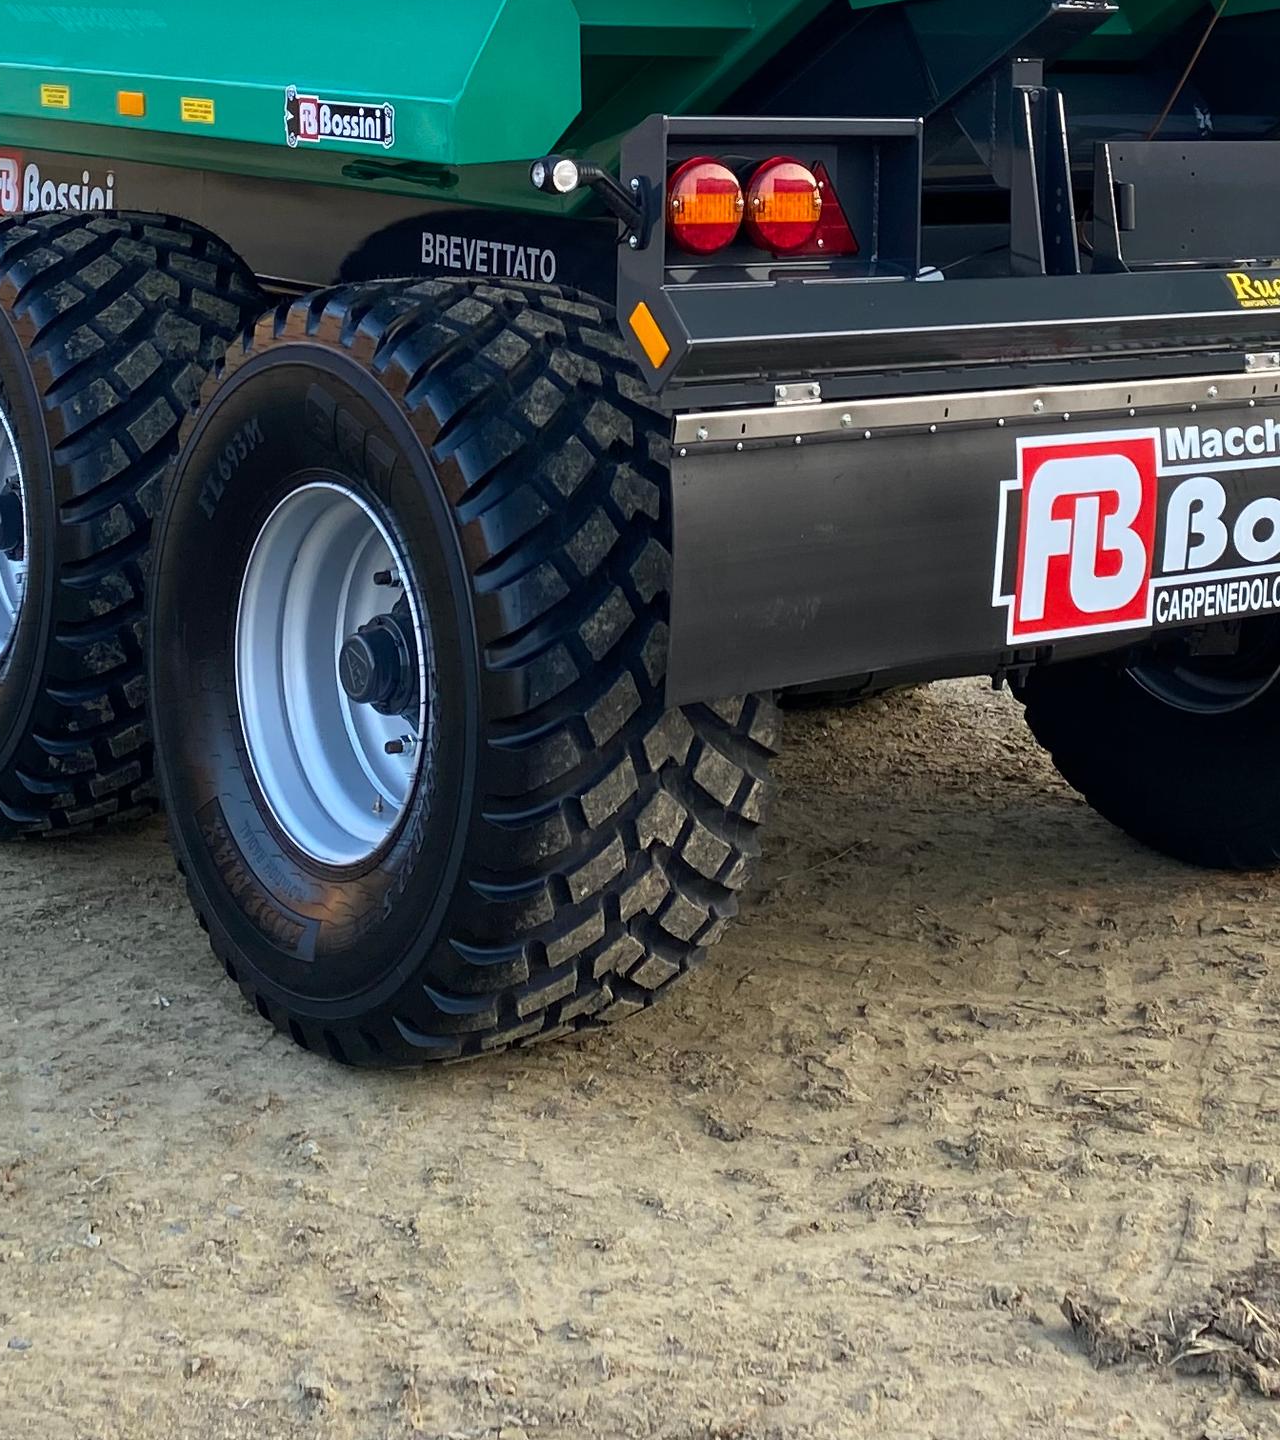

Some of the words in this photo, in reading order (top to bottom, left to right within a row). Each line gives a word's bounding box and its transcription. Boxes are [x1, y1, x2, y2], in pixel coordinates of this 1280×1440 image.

[320, 104, 381, 140] Bossini
[23, 163, 115, 212] Bossini
[421, 231, 557, 283] BREVETTATO
